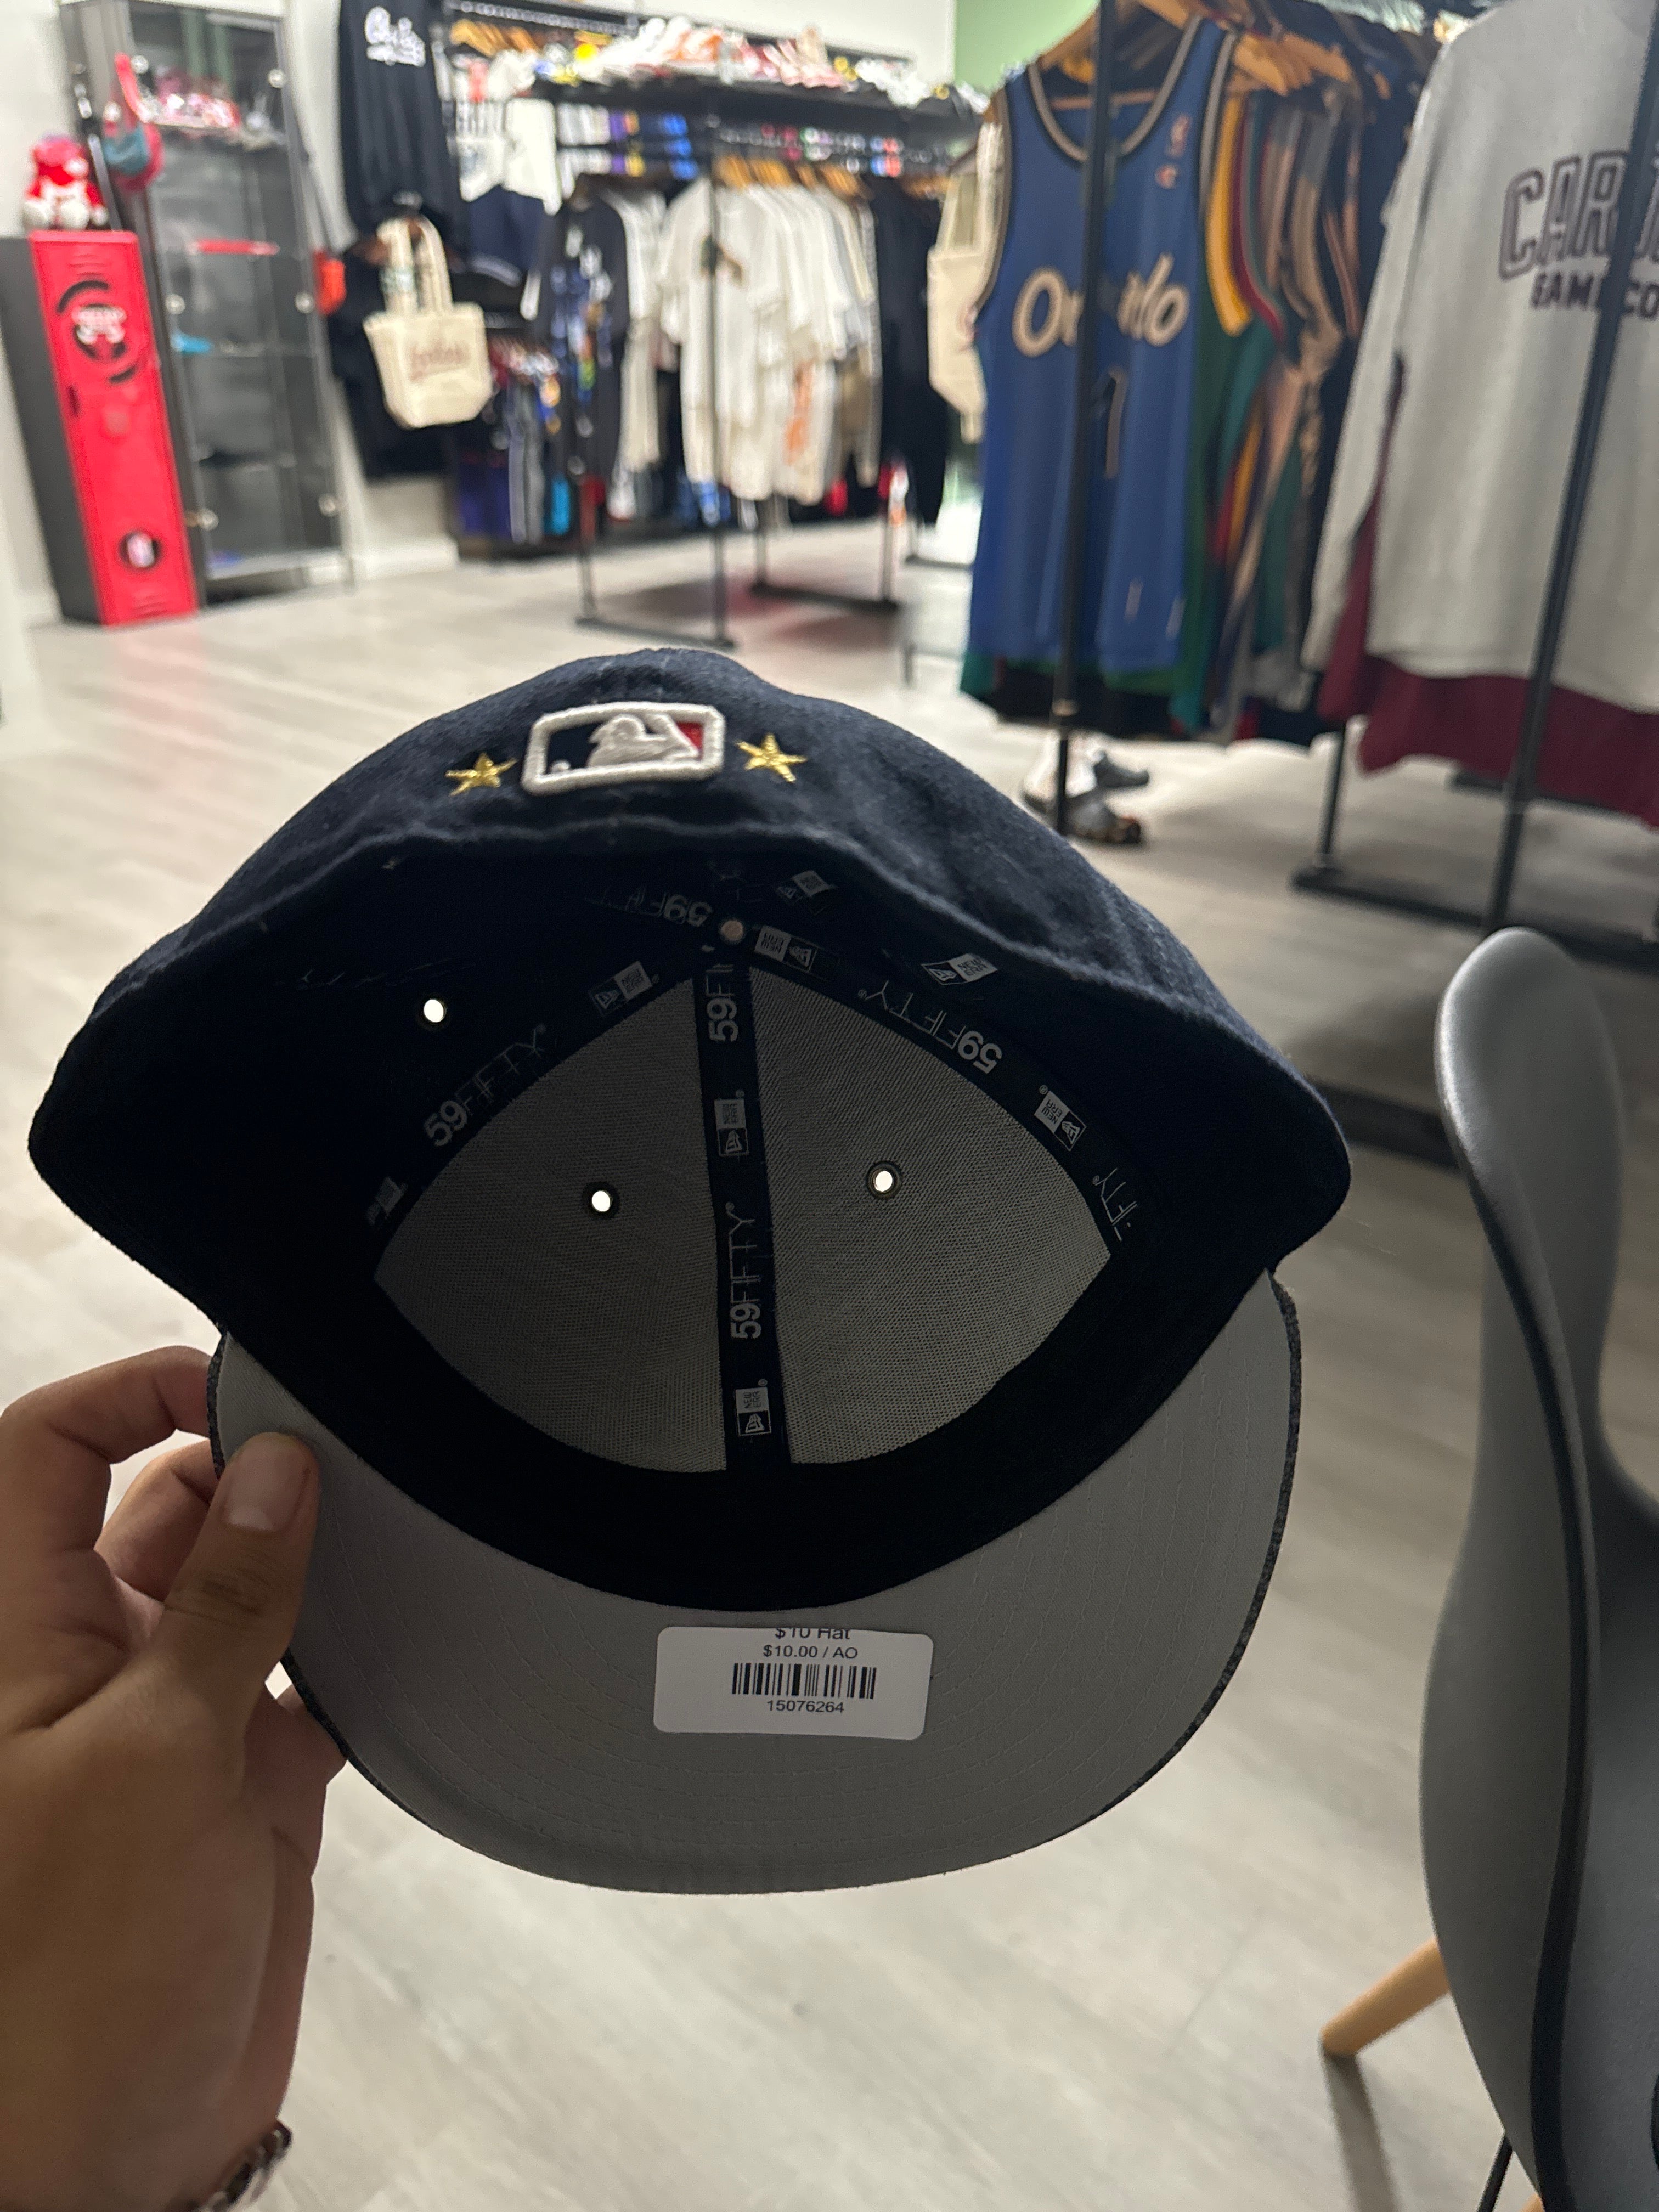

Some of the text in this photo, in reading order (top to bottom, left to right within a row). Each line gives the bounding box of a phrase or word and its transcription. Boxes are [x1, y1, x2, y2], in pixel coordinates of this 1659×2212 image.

[775, 1628, 850, 1639] $10 Hat
[763, 1645, 817, 1657] $10.00
[823, 1647, 828, 1658] /
[767, 1700, 844, 1713] 15076264
